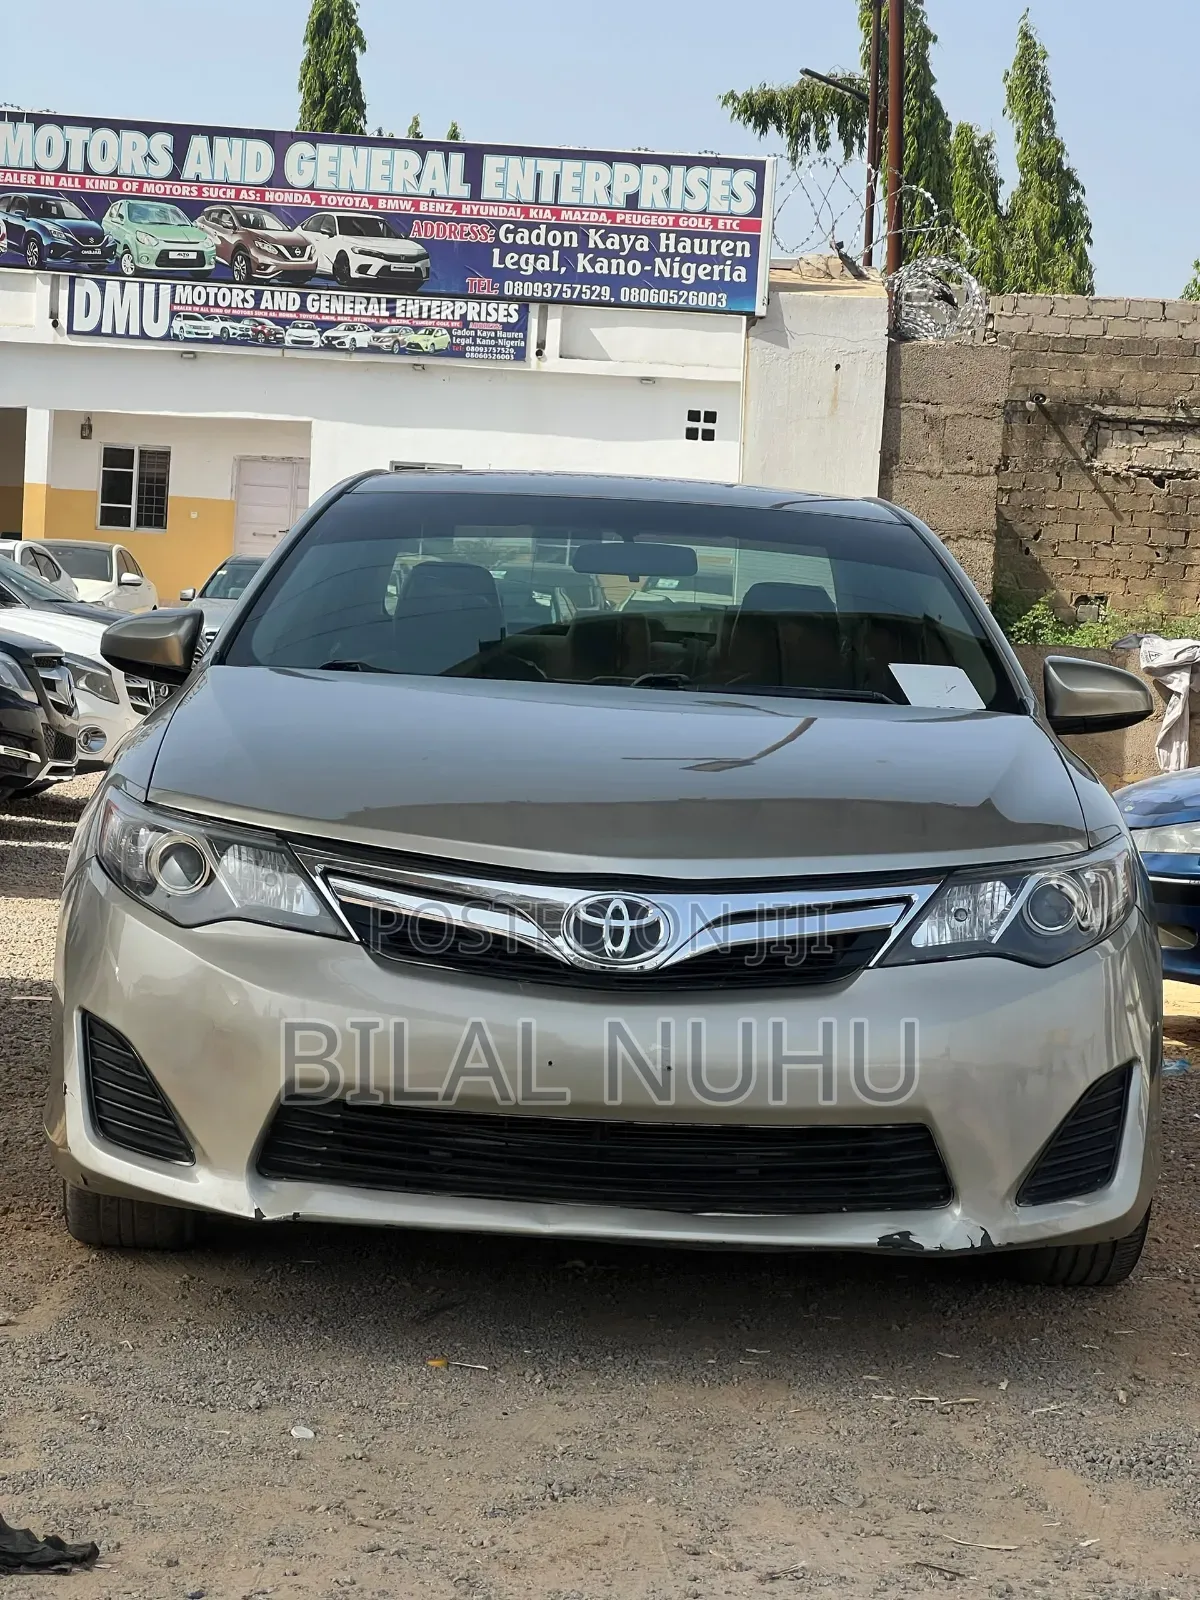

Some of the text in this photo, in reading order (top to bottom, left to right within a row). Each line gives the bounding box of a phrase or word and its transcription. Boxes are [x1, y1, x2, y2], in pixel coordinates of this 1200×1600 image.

[0, 121, 757, 215] MOTORS AND GENERAL ENTERPRISES
[40, 175, 55, 186] IN
[58, 176, 81, 188] ALL
[85, 178, 118, 190] KIND
[122, 181, 139, 192] OF
[142, 183, 199, 197] MOTORS
[202, 186, 235, 199] SUCH
[239, 189, 261, 202] AS:
[265, 191, 316, 206] HONDA,
[320, 194, 373, 210] TOYOTA,
[378, 200, 415, 212] BMW,
[419, 203, 457, 215] BENZ,
[461, 204, 525, 219] HYUNDAI,
[529, 208, 556, 221] KIA,
[560, 210, 612, 225] MAZDA,
[616, 213, 675, 227] PEUGEOT
[679, 217, 714, 231] GOLF,
[718, 220, 740, 230] ETC
[409, 219, 751, 258] ADDRESS: Gadon Kaya Hauren
[492, 248, 748, 284] Legal, Kano-Nigeria
[73, 278, 519, 339] DMU MOTORS AND GENERAL ENTERPRISES
[466, 277, 728, 308] TEL: 08093757529, 08060526003
[452, 328, 524, 339] Gadon Kaya Hauren
[452, 337, 525, 348] Legal, Kano-Nigeria
